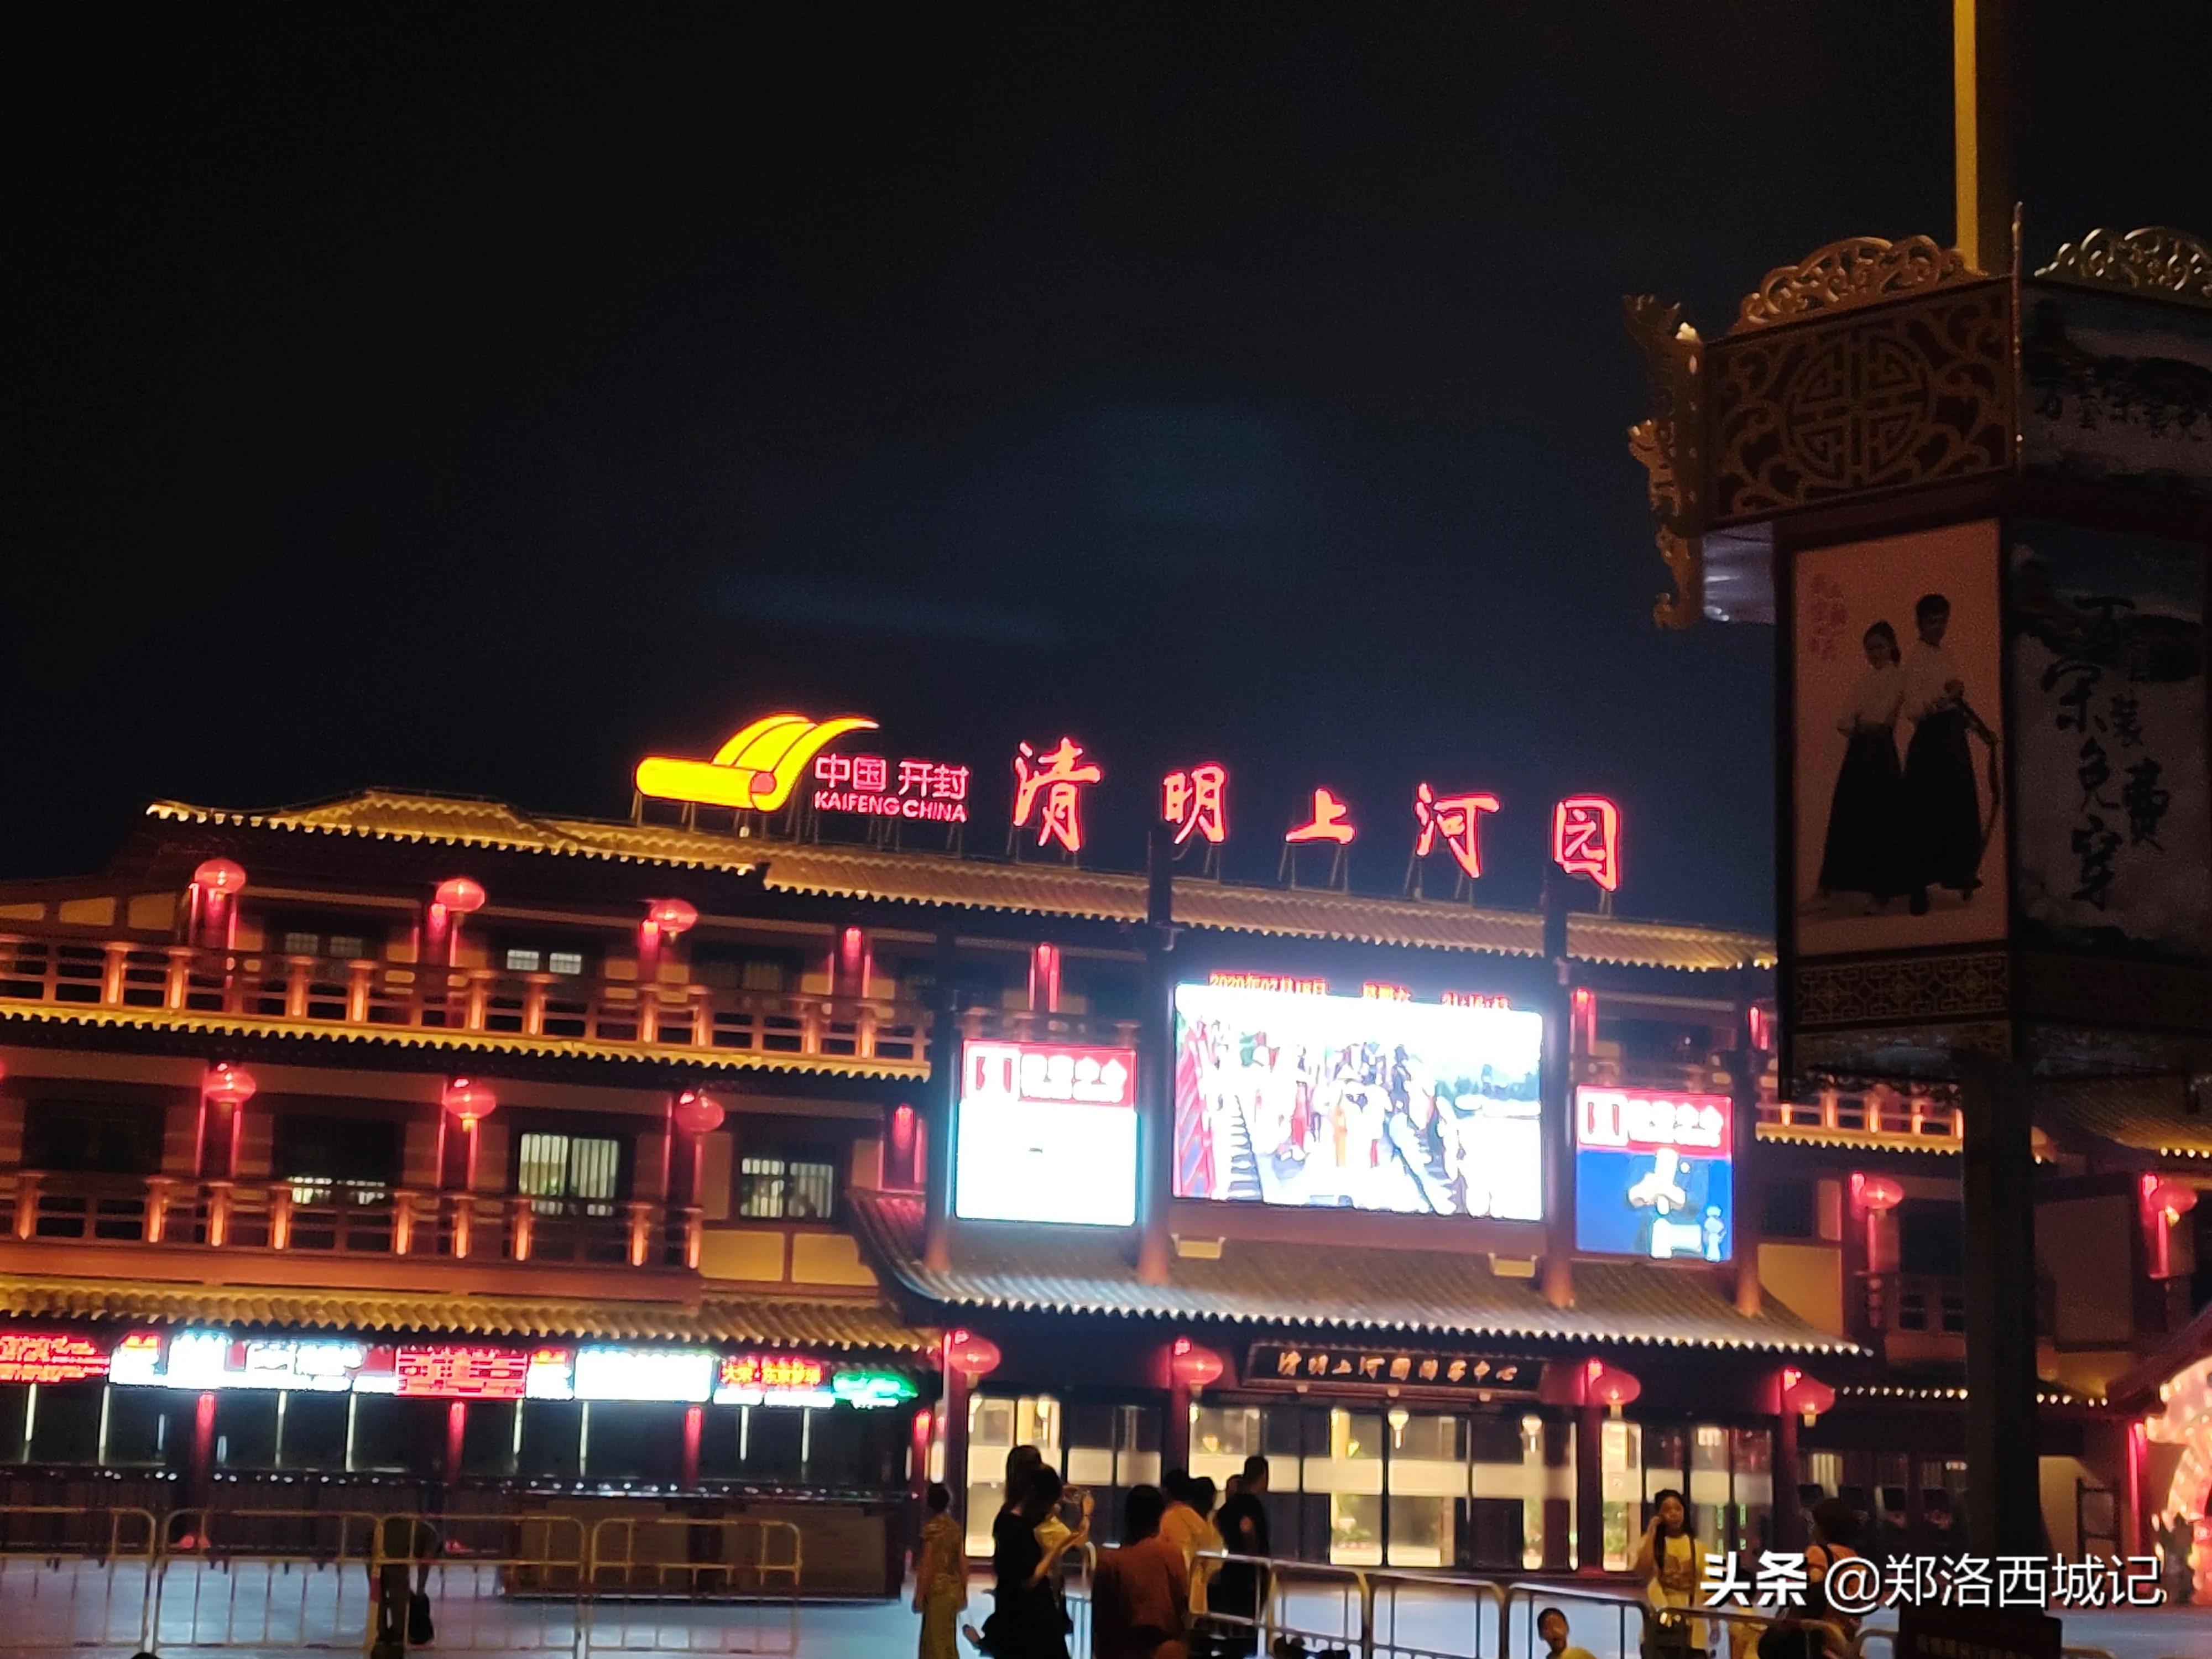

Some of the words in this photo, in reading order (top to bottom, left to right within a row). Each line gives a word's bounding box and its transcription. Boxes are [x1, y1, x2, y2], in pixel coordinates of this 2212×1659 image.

[815, 753, 887, 792] 中国
[898, 760, 970, 800] 开封
[814, 791, 900, 815] KAIFENG
[902, 799, 967, 823] CHINA
[1011, 735, 1620, 891] 清明上河园
